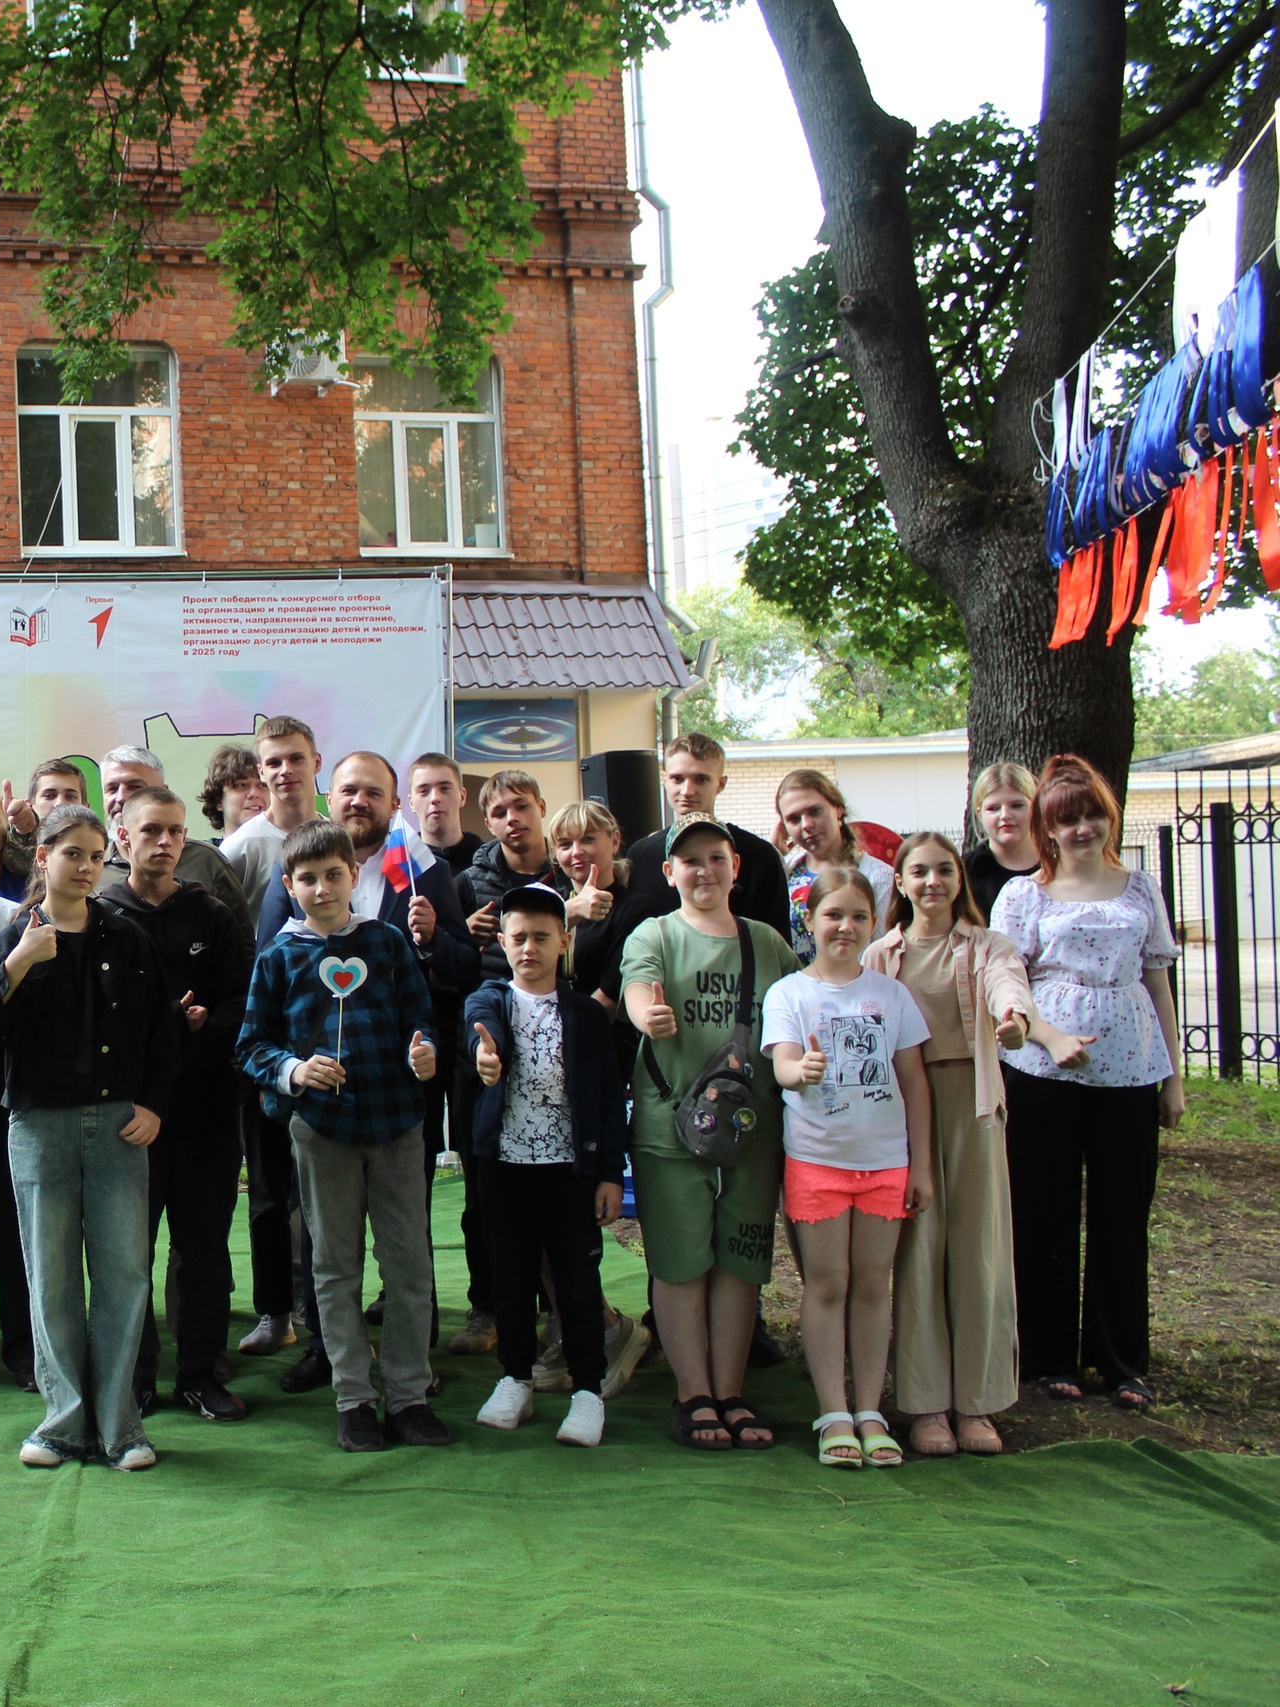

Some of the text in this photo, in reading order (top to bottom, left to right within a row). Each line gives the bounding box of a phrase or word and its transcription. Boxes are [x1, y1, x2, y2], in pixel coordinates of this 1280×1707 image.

[85, 596, 114, 605] Первые
[183, 593, 381, 605] Проект победитель конкурсного отбора
[199, 607, 265, 615] организацию
[278, 606, 336, 614] проведение
[339, 605, 391, 613] проектной
[183, 617, 242, 625] активности,
[246, 616, 317, 625] направленной
[335, 615, 396, 623] воспитание,
[183, 628, 229, 636] развитие
[242, 627, 329, 635] самореализацию
[332, 626, 360, 634] детей
[372, 625, 427, 634] молодежи,
[184, 638, 250, 647] организацию
[254, 638, 287, 646] досуга
[290, 637, 319, 646] детей
[330, 637, 382, 645] молодежи
[184, 647, 240, 657] в 2025 году
[696, 970, 756, 1000] USU
[683, 999, 763, 1030] SUSP
[739, 1222, 774, 1241] USUA
